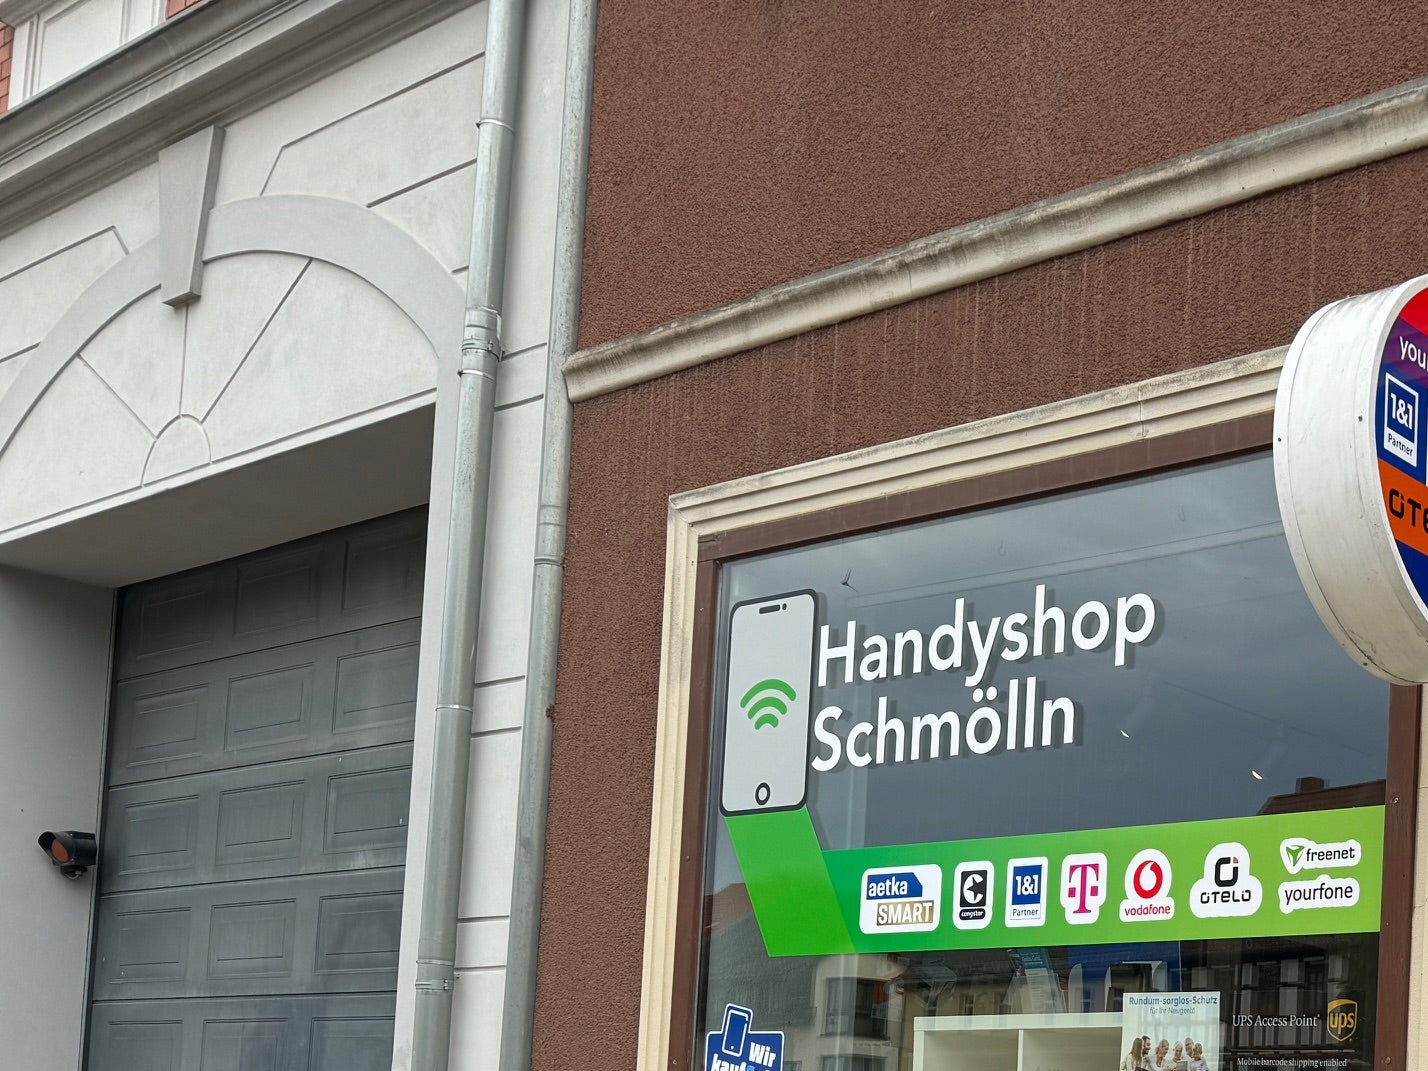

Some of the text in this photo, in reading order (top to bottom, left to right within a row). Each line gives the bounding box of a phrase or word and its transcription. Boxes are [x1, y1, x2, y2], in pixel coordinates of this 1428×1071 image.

[1390, 391, 1413, 431] 1&1
[1387, 434, 1413, 456] Partner
[816, 583, 1156, 688] Handyshop
[811, 677, 1076, 773] Schmölln
[1306, 846, 1355, 862] freenet
[868, 876, 908, 898] aetka
[1015, 874, 1039, 896] 1&1
[1068, 863, 1099, 913] T
[1284, 883, 1353, 905] yourfone
[877, 902, 933, 925] SMART
[1012, 907, 1039, 918] Partner
[1124, 904, 1171, 917] vodafone
[1129, 995, 1218, 1007] Rundum-sorglos-Schutz
[1232, 1014, 1253, 1027] UPS
[1255, 1014, 1288, 1027] Access
[1330, 1011, 1355, 1035] ups
[749, 1042, 777, 1068] Wir
[1237, 1057, 1348, 1069] Mobile barcode shipping enabled
